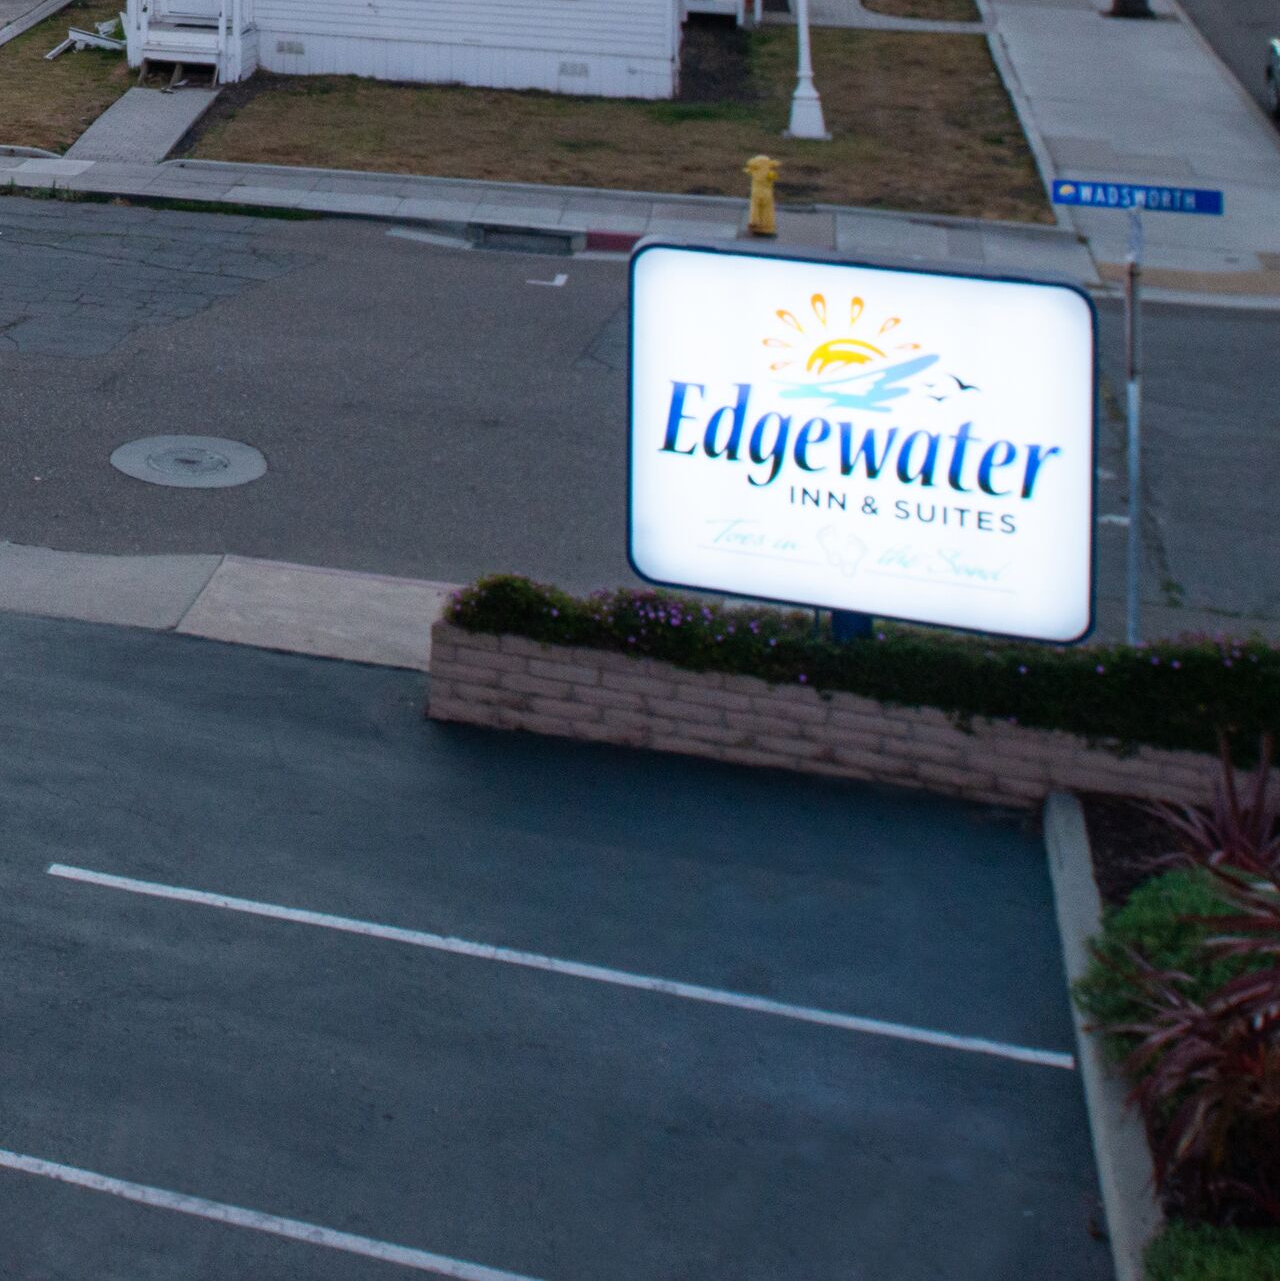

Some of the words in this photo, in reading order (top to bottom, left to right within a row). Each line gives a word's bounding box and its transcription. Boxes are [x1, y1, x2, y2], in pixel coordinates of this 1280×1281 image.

[1077, 184, 1197, 210] WADSWORTH
[657, 379, 1062, 500] Edgewater
[789, 485, 848, 511] INN
[860, 495, 879, 516] &
[894, 499, 1018, 535] SUITES
